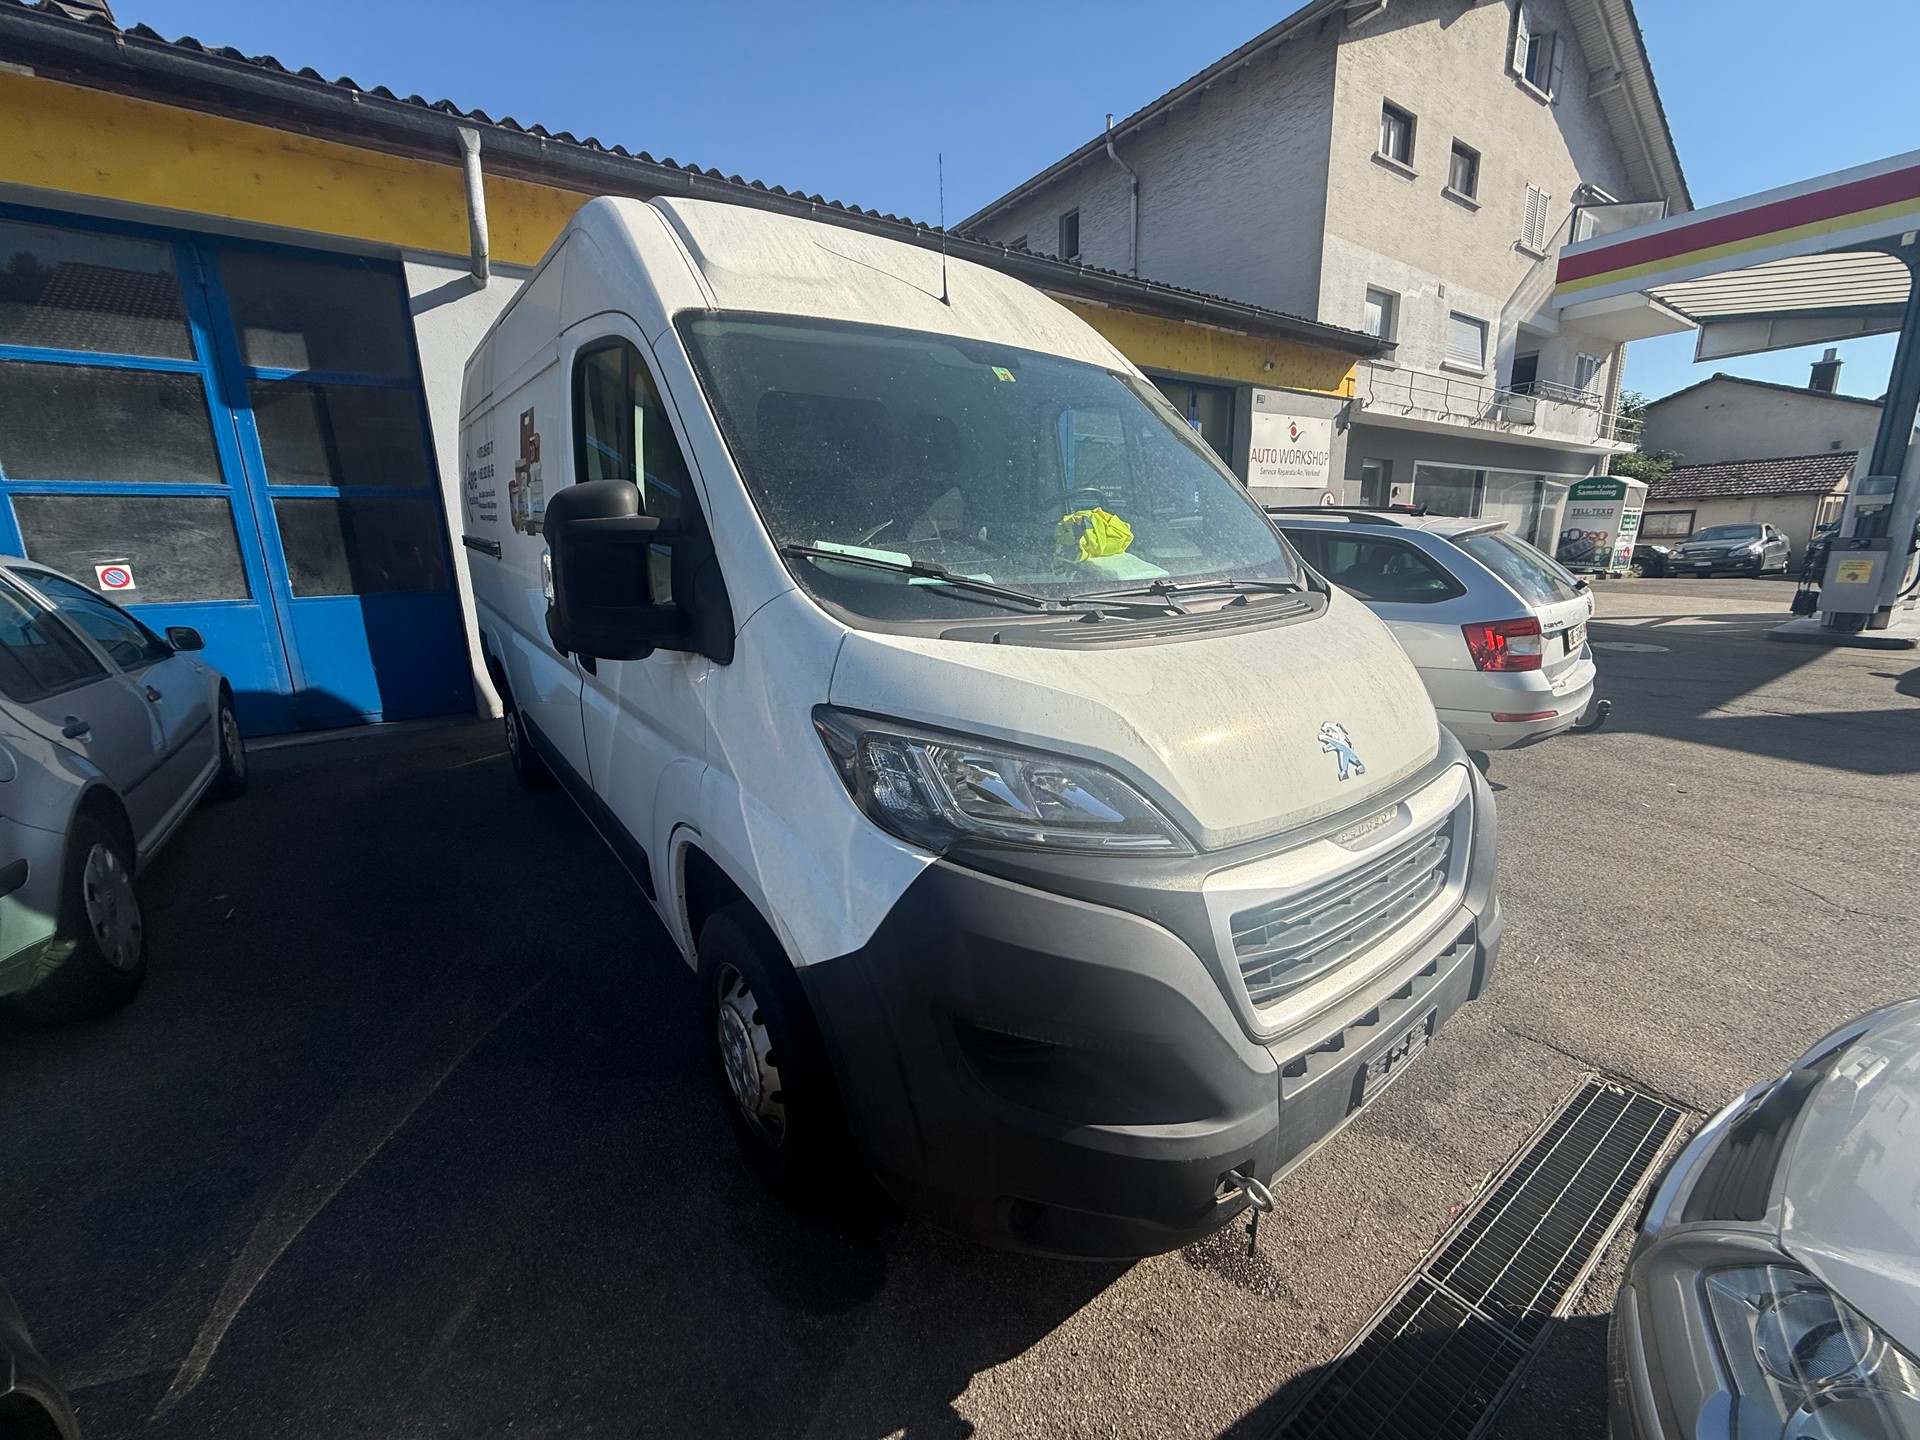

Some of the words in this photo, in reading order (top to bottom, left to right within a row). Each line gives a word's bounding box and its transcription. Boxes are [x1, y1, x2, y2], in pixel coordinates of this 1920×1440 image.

[1251, 448, 1277, 463] AUTO
[1279, 449, 1329, 466] WORKSHOP
[1260, 467, 1277, 476] Service
[1576, 489, 1617, 497] Sammlung
[1341, 808, 1395, 841] PEUGEOT
